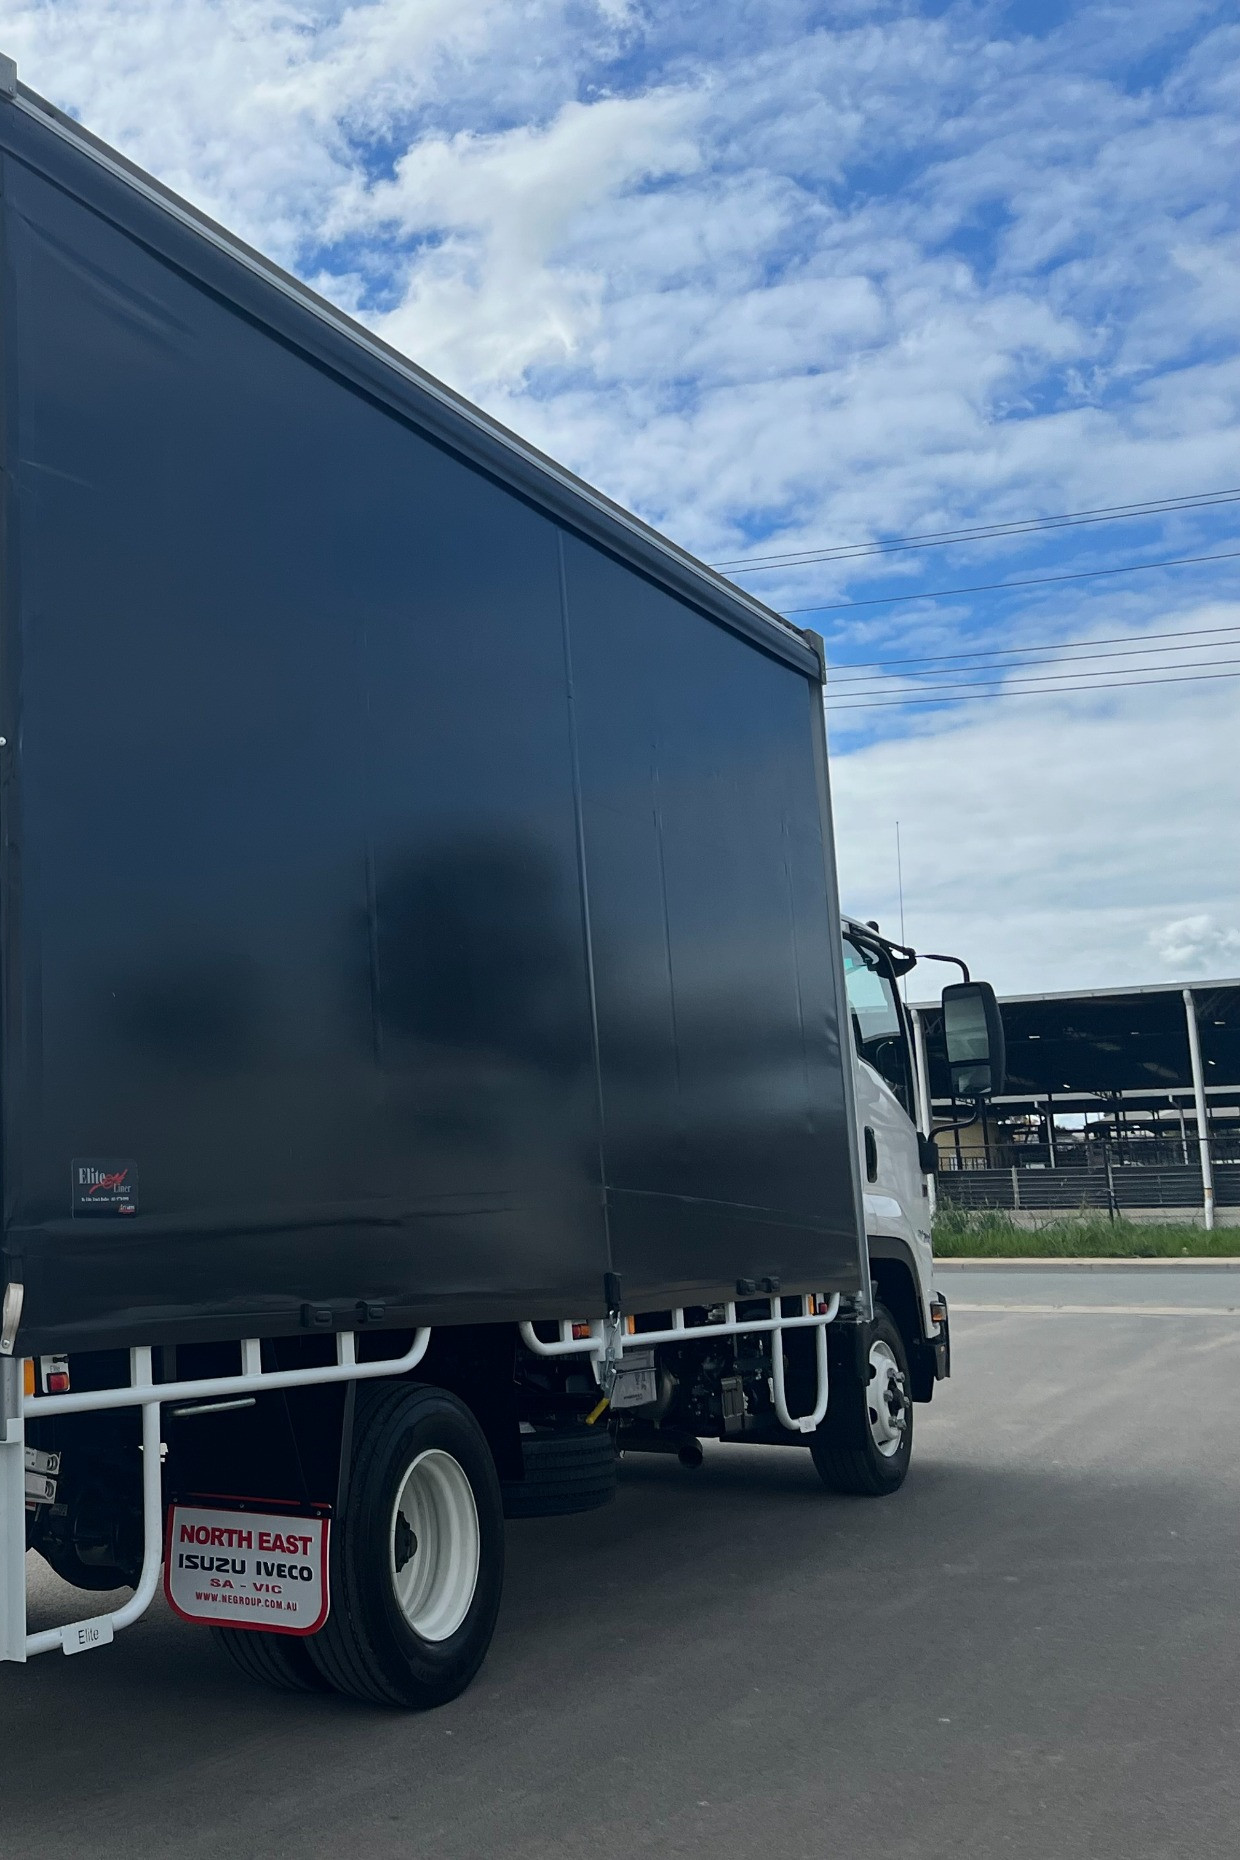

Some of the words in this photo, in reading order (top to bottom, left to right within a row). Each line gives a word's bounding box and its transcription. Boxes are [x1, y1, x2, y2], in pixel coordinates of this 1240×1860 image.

[78, 1167, 106, 1185] Elite
[180, 1525, 253, 1549] NORTH
[258, 1532, 313, 1556] EAST
[178, 1553, 246, 1575] ISUZU
[256, 1561, 313, 1581] IVECO
[210, 1578, 234, 1589] SA
[252, 1582, 283, 1594] VIC
[195, 1591, 298, 1612] WWW.NEGROUP.COM.AU
[78, 1628, 100, 1645] Elite
